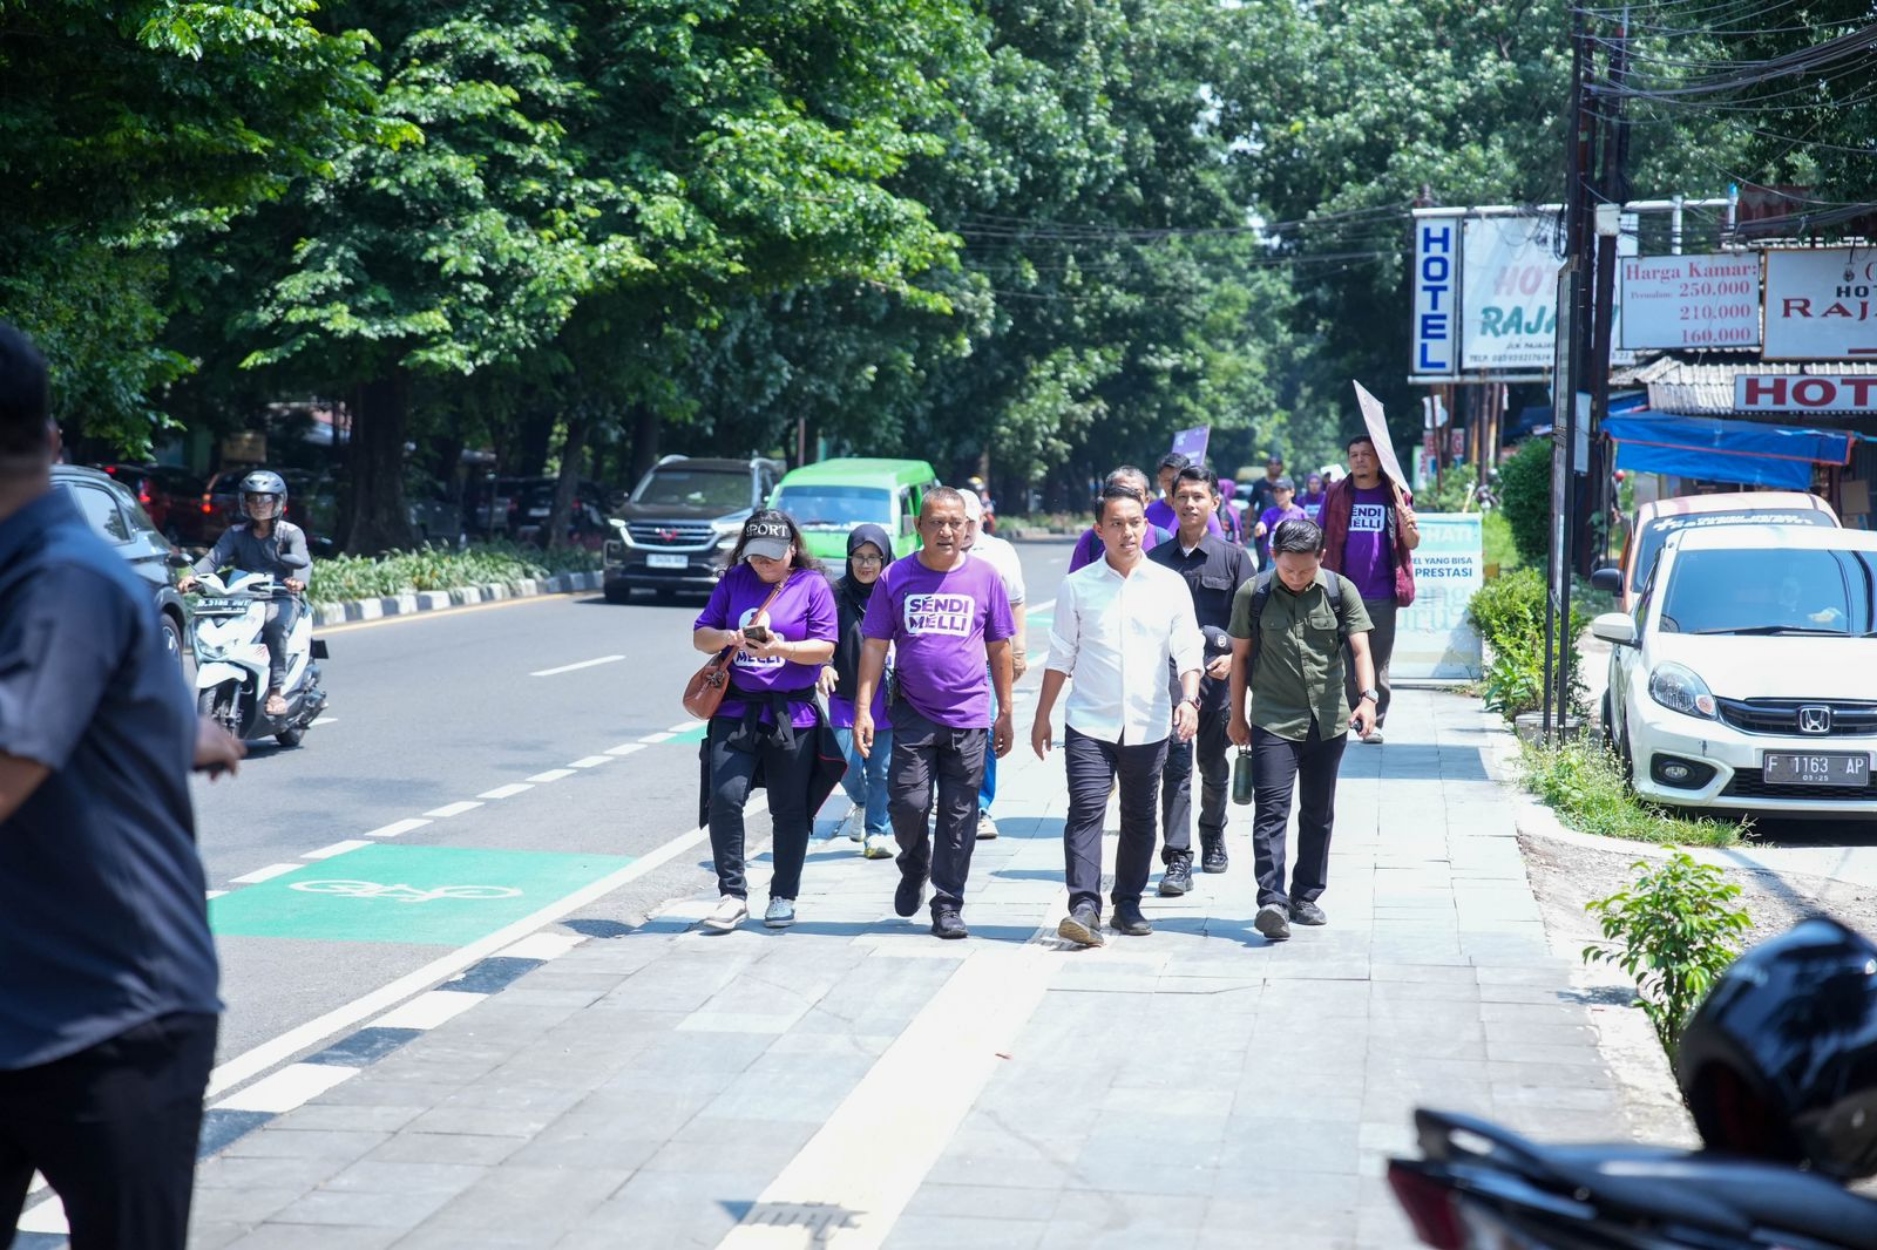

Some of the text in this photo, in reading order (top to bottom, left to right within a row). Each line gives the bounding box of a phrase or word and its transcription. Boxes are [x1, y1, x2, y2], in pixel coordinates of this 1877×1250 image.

[1626, 261, 1757, 284] Harga Kamar:
[1679, 281, 1750, 297] 250.000
[1420, 227, 1450, 369] HOTEL
[1680, 304, 1750, 320] 210.000
[1782, 298, 1877, 321] RAJ
[1682, 327, 1750, 343] 160.000
[1425, 557, 1450, 565] YANG
[1451, 557, 1473, 565] BISA
[1415, 568, 1473, 578] PRESTASI
[1768, 756, 1864, 774] F 1163 AP
